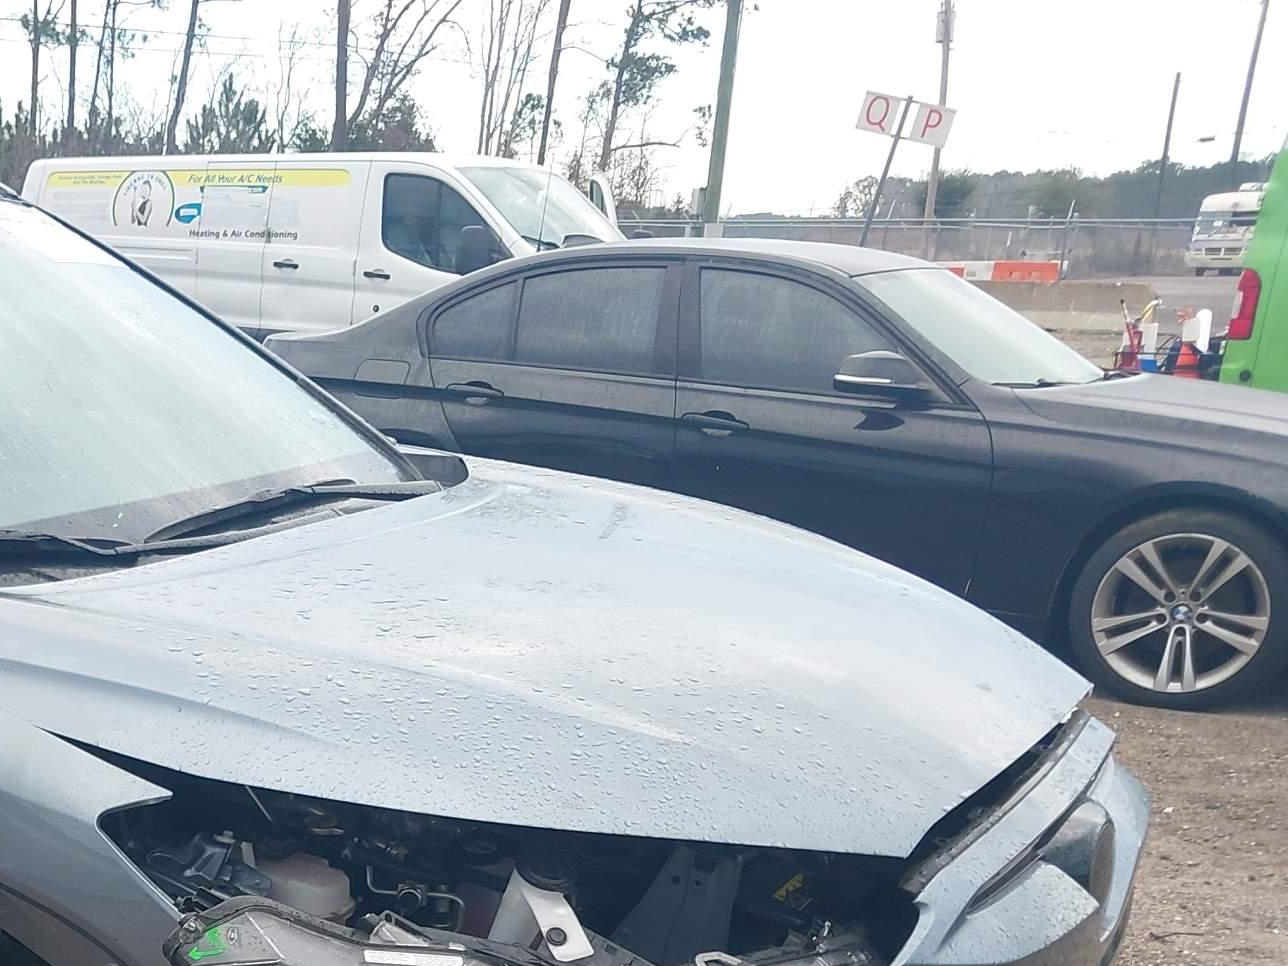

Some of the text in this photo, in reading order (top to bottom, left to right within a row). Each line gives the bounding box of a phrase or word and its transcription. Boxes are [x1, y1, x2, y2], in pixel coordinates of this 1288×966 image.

[866, 95, 890, 132] Q
[920, 108, 943, 138] P
[188, 175, 283, 184] For All Your A/C Needs
[189, 229, 220, 239] Heating
[231, 230, 242, 238] Air
